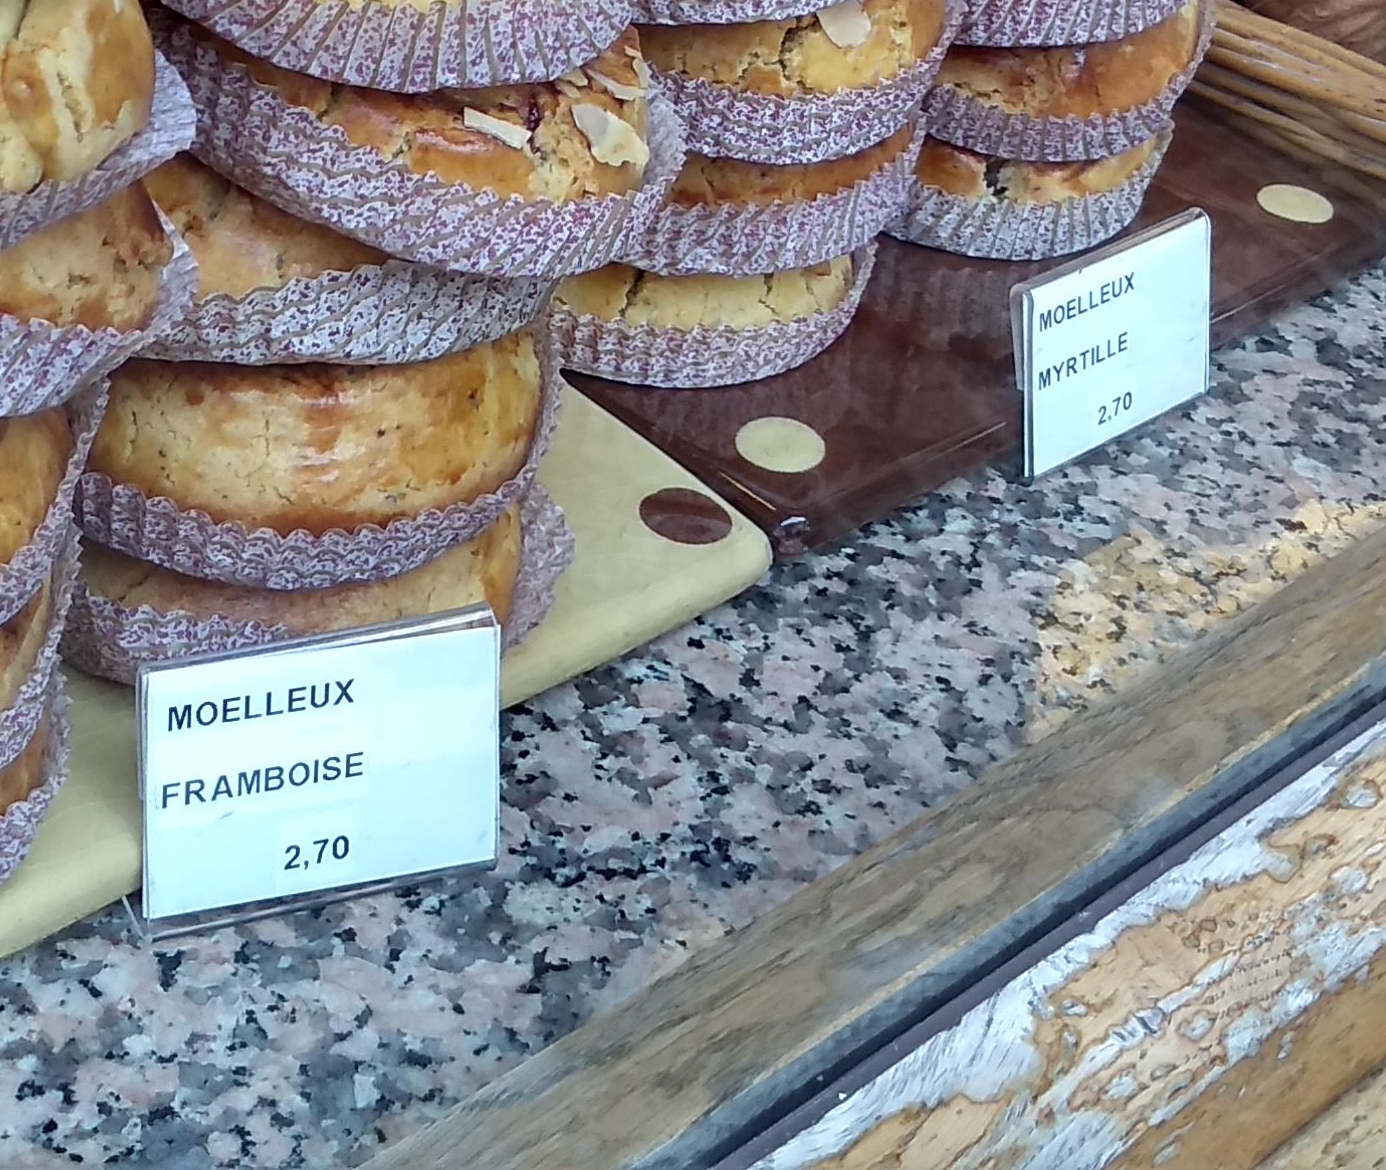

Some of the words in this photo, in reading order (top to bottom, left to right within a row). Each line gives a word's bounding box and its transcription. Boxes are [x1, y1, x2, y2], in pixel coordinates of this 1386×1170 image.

[1038, 271, 1136, 333] MOELLEUX
[1037, 331, 1129, 391] MYRTILLE
[167, 678, 355, 732] MOELLEUX
[161, 751, 364, 810] FRAMBOISE
[283, 835, 350, 871] 2,70
